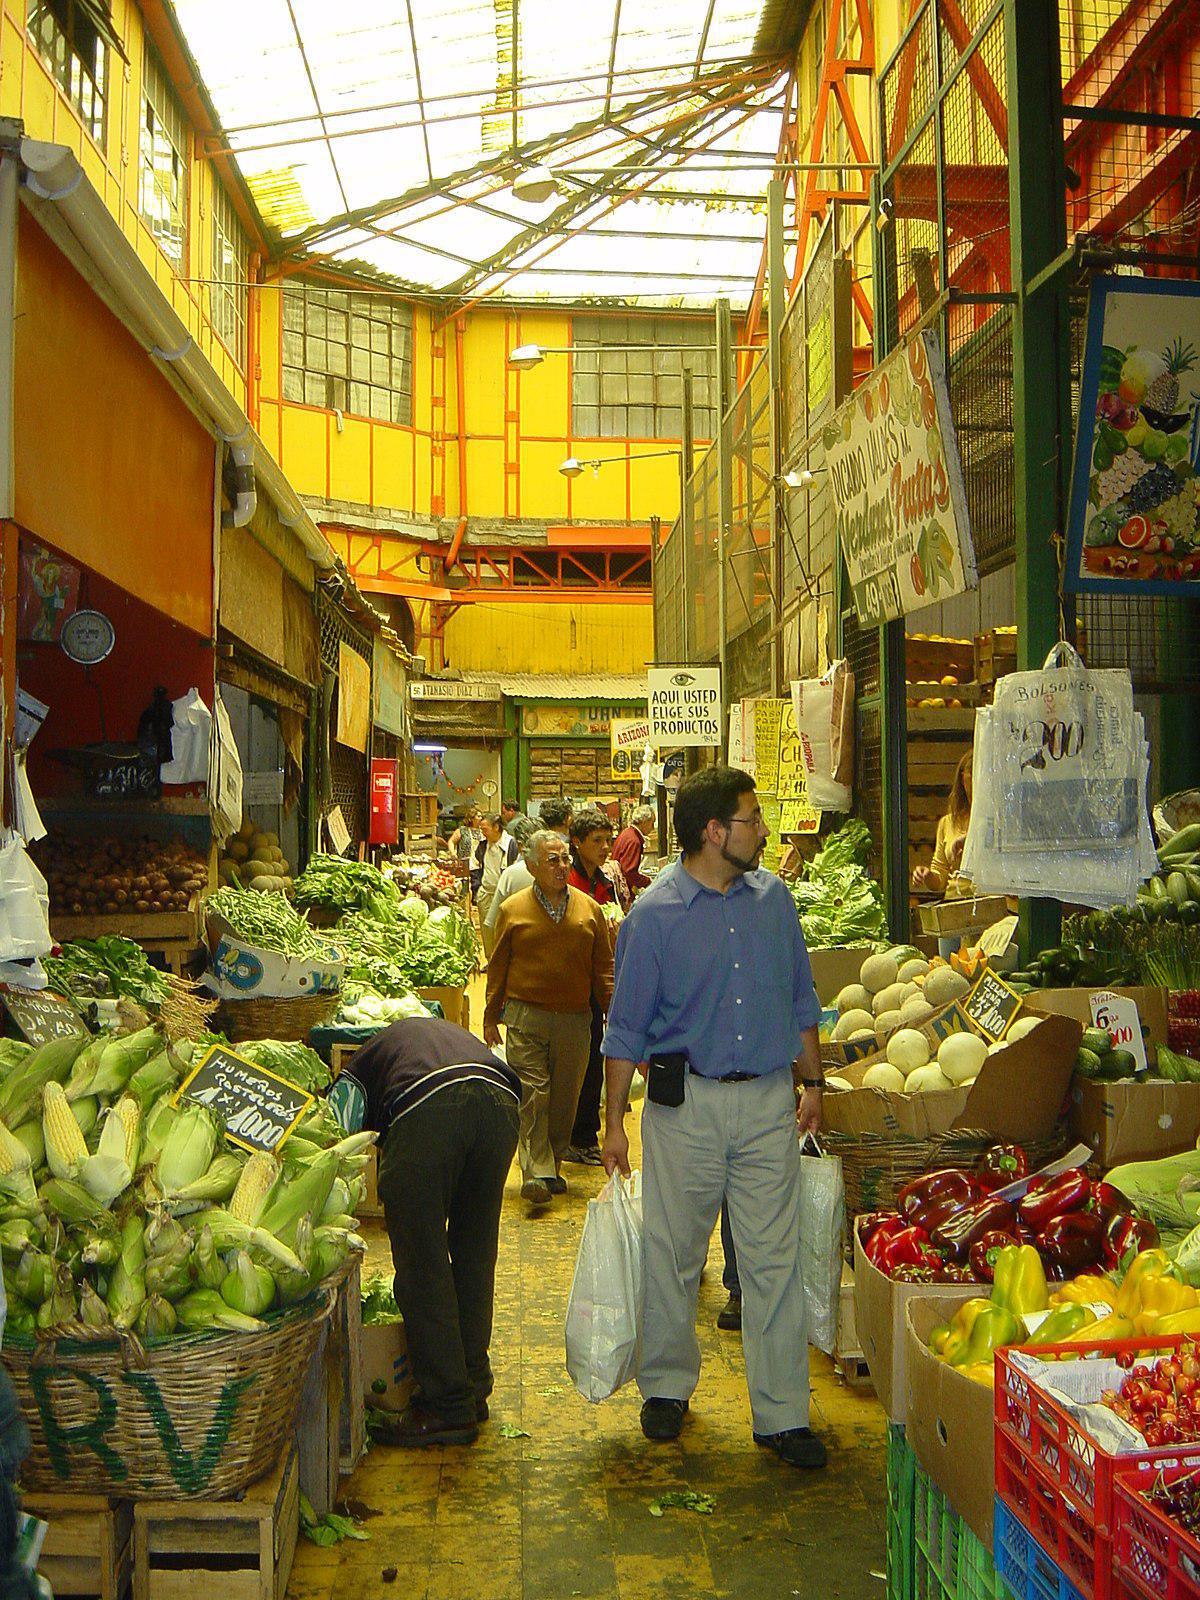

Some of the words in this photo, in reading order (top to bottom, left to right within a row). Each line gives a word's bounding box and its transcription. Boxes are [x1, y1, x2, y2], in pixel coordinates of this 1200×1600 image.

[652, 690, 679, 704] AQUI
[684, 690, 717, 704] USTED
[653, 706, 683, 719] ELIGE
[688, 706, 709, 718] SUS
[654, 720, 718, 735] PRODUCTOS
[1096, 1006, 1110, 1029] 6
[226, 1104, 285, 1150] 1000
